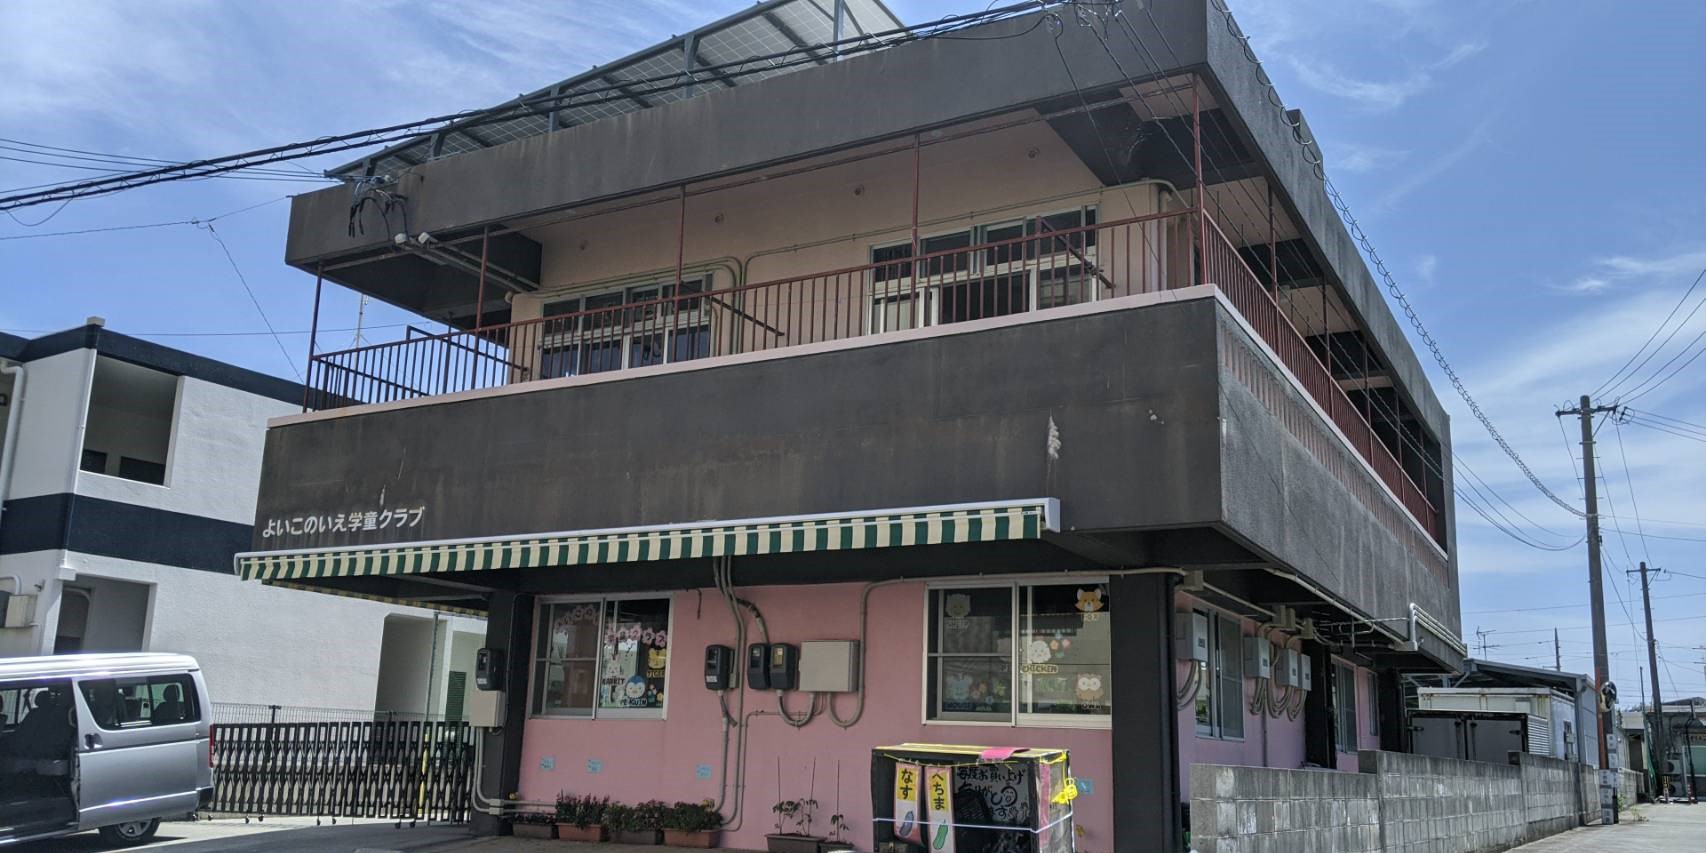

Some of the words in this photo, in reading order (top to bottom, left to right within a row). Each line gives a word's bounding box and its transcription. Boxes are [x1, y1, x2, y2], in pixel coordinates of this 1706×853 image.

[262, 506, 425, 538] よいこのいえ学童クラブ
[1021, 664, 1057, 673] CHICKEN
[900, 768, 913, 800] なす
[932, 772, 945, 811] へちま
